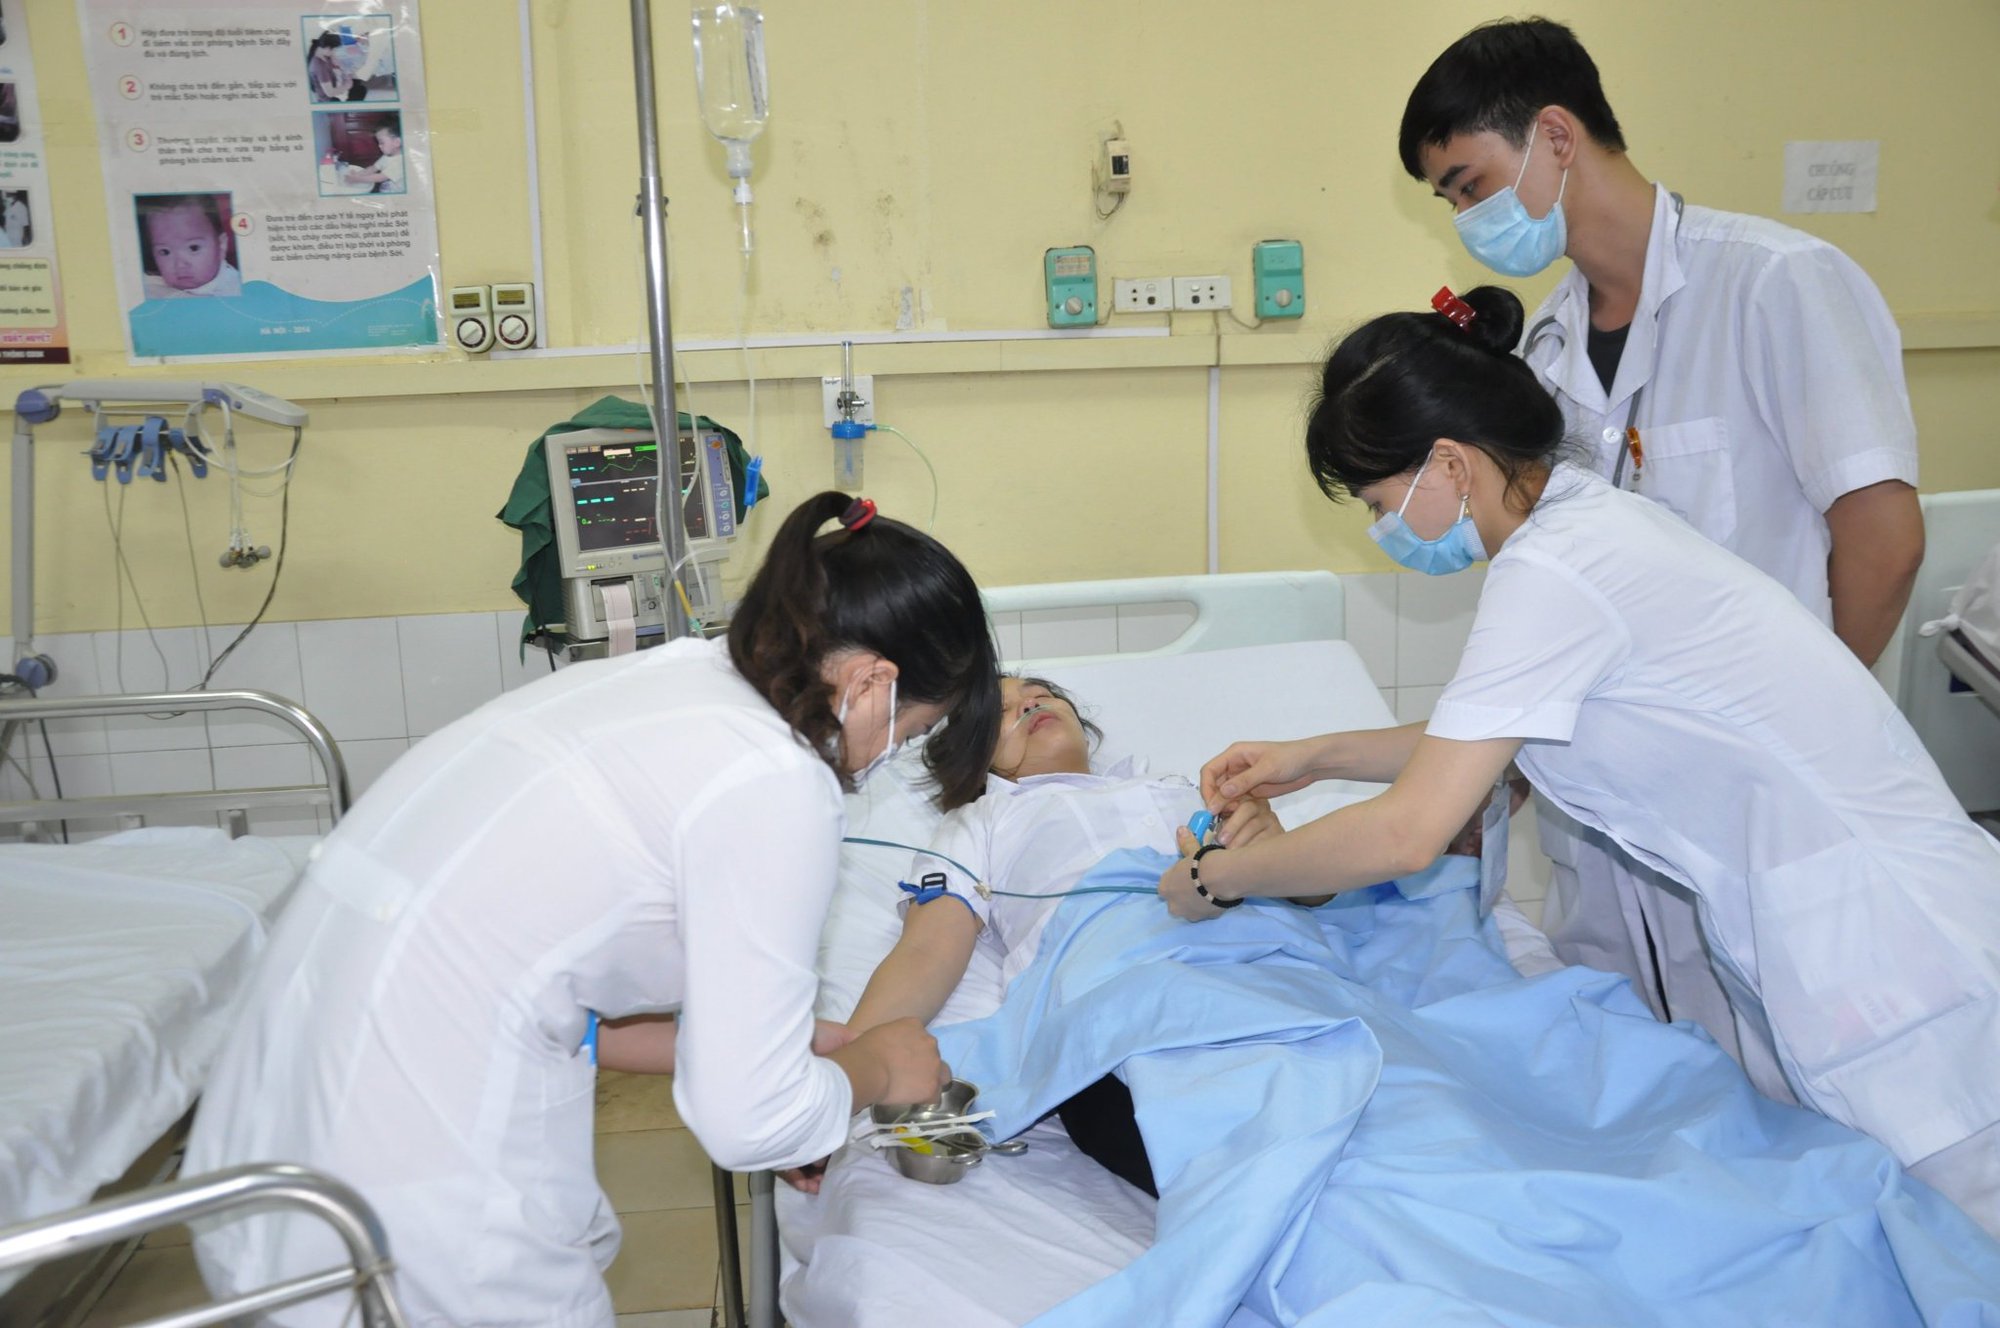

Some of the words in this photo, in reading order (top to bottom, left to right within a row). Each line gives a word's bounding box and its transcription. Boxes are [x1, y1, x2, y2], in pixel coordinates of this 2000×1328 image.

[118, 27, 126, 40] 1
[126, 81, 136, 93] 2
[133, 134, 144, 146] 3
[238, 218, 247, 230] 4
